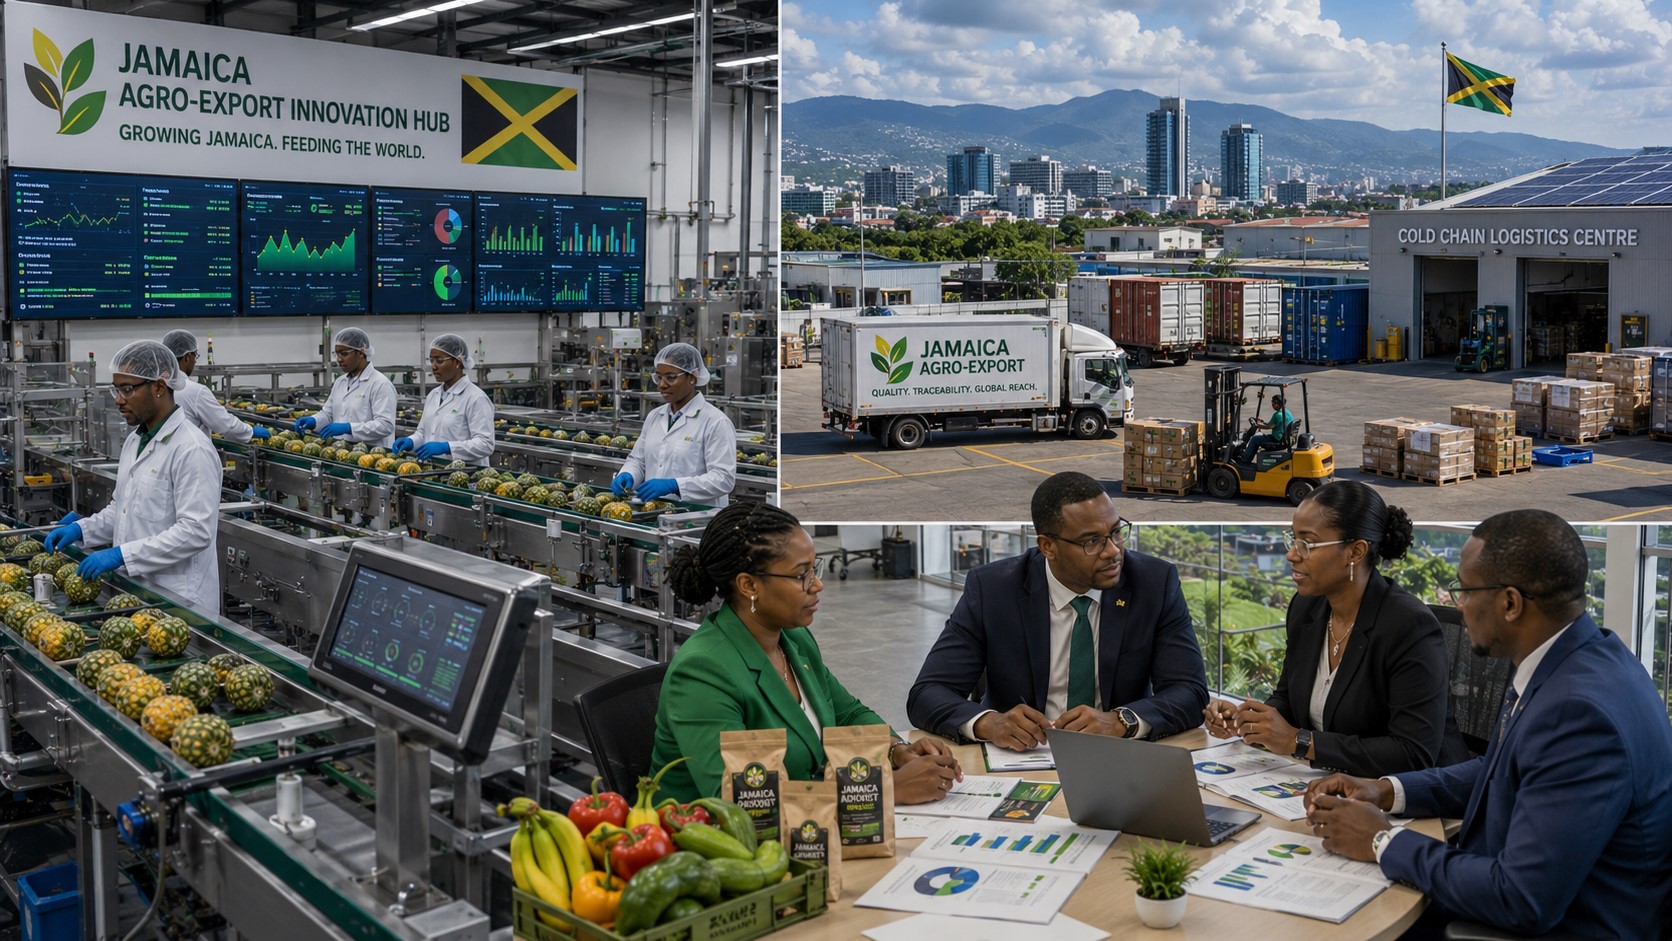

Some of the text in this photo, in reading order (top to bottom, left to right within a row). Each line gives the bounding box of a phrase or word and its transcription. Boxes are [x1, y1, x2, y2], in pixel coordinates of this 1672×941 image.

[118, 42, 252, 85] JAMAICA
[118, 82, 450, 133] AGRO-EXPORT INNOVATION HUB
[119, 123, 425, 159] GROWING JAMAICA. FEEDING THE WORLD.
[1398, 228, 1638, 246] COLD CHAIN LOGISTICS CENTRE
[920, 338, 1011, 359] JAMAICA
[919, 358, 1026, 376] AGRO-EXPORT
[871, 382, 1038, 398] QUALITY. TRACEABILITY. GLOBAL REACH.
[738, 789, 775, 799] JAMAICA
[841, 784, 878, 794] JAMAICA
